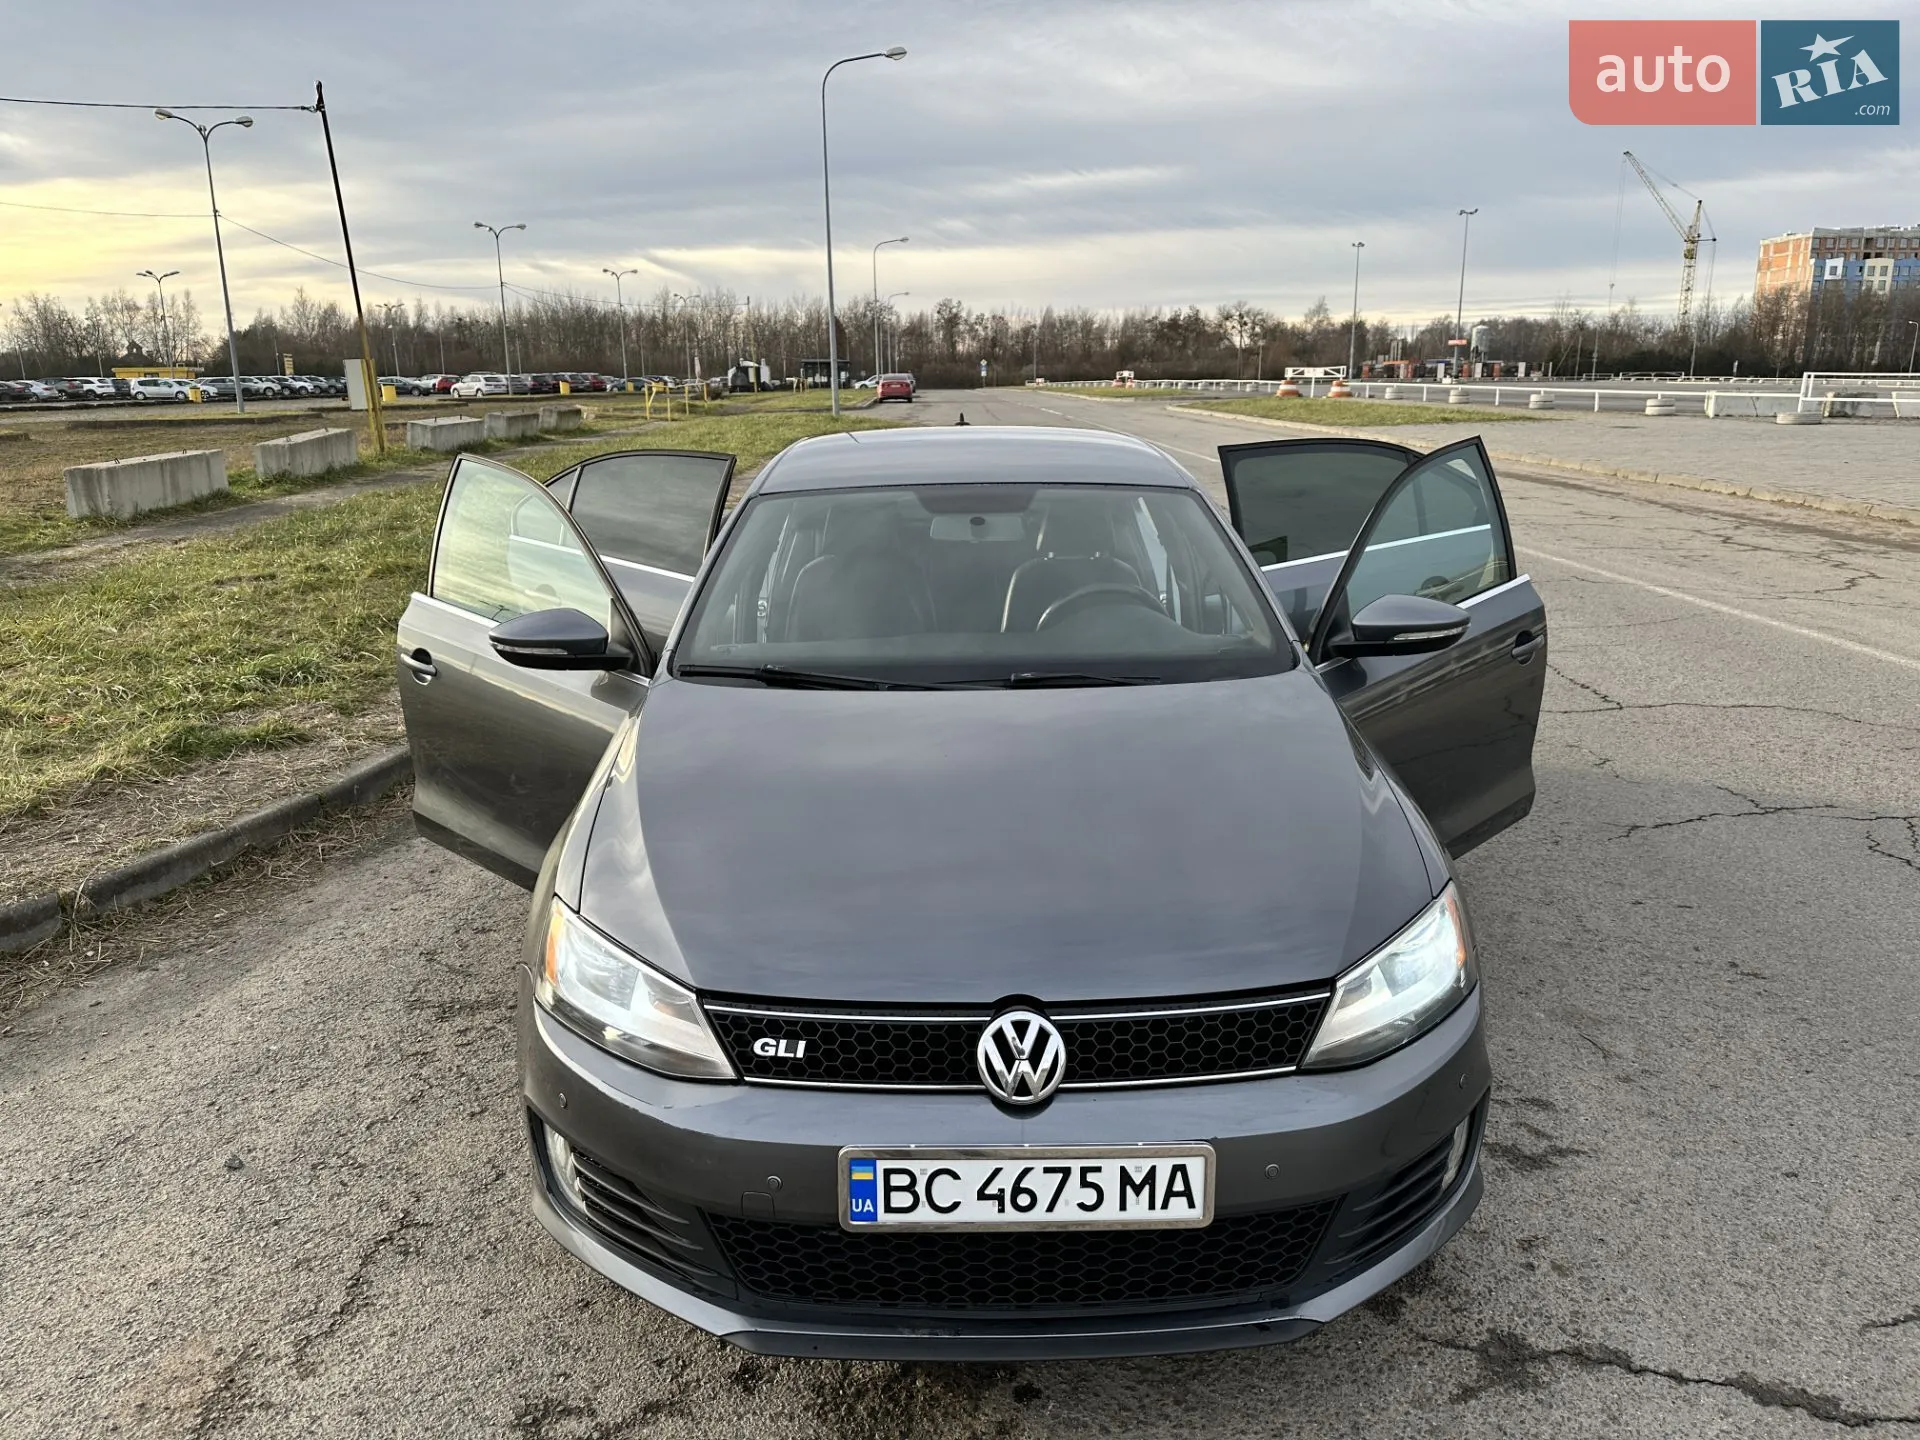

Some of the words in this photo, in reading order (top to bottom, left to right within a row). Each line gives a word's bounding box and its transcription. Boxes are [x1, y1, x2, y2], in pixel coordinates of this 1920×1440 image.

[752, 1037, 807, 1059] GLI
[882, 1166, 962, 1215] BC
[976, 1165, 1105, 1214] 4675
[1118, 1163, 1196, 1212] MA
[852, 1199, 874, 1213] UA
